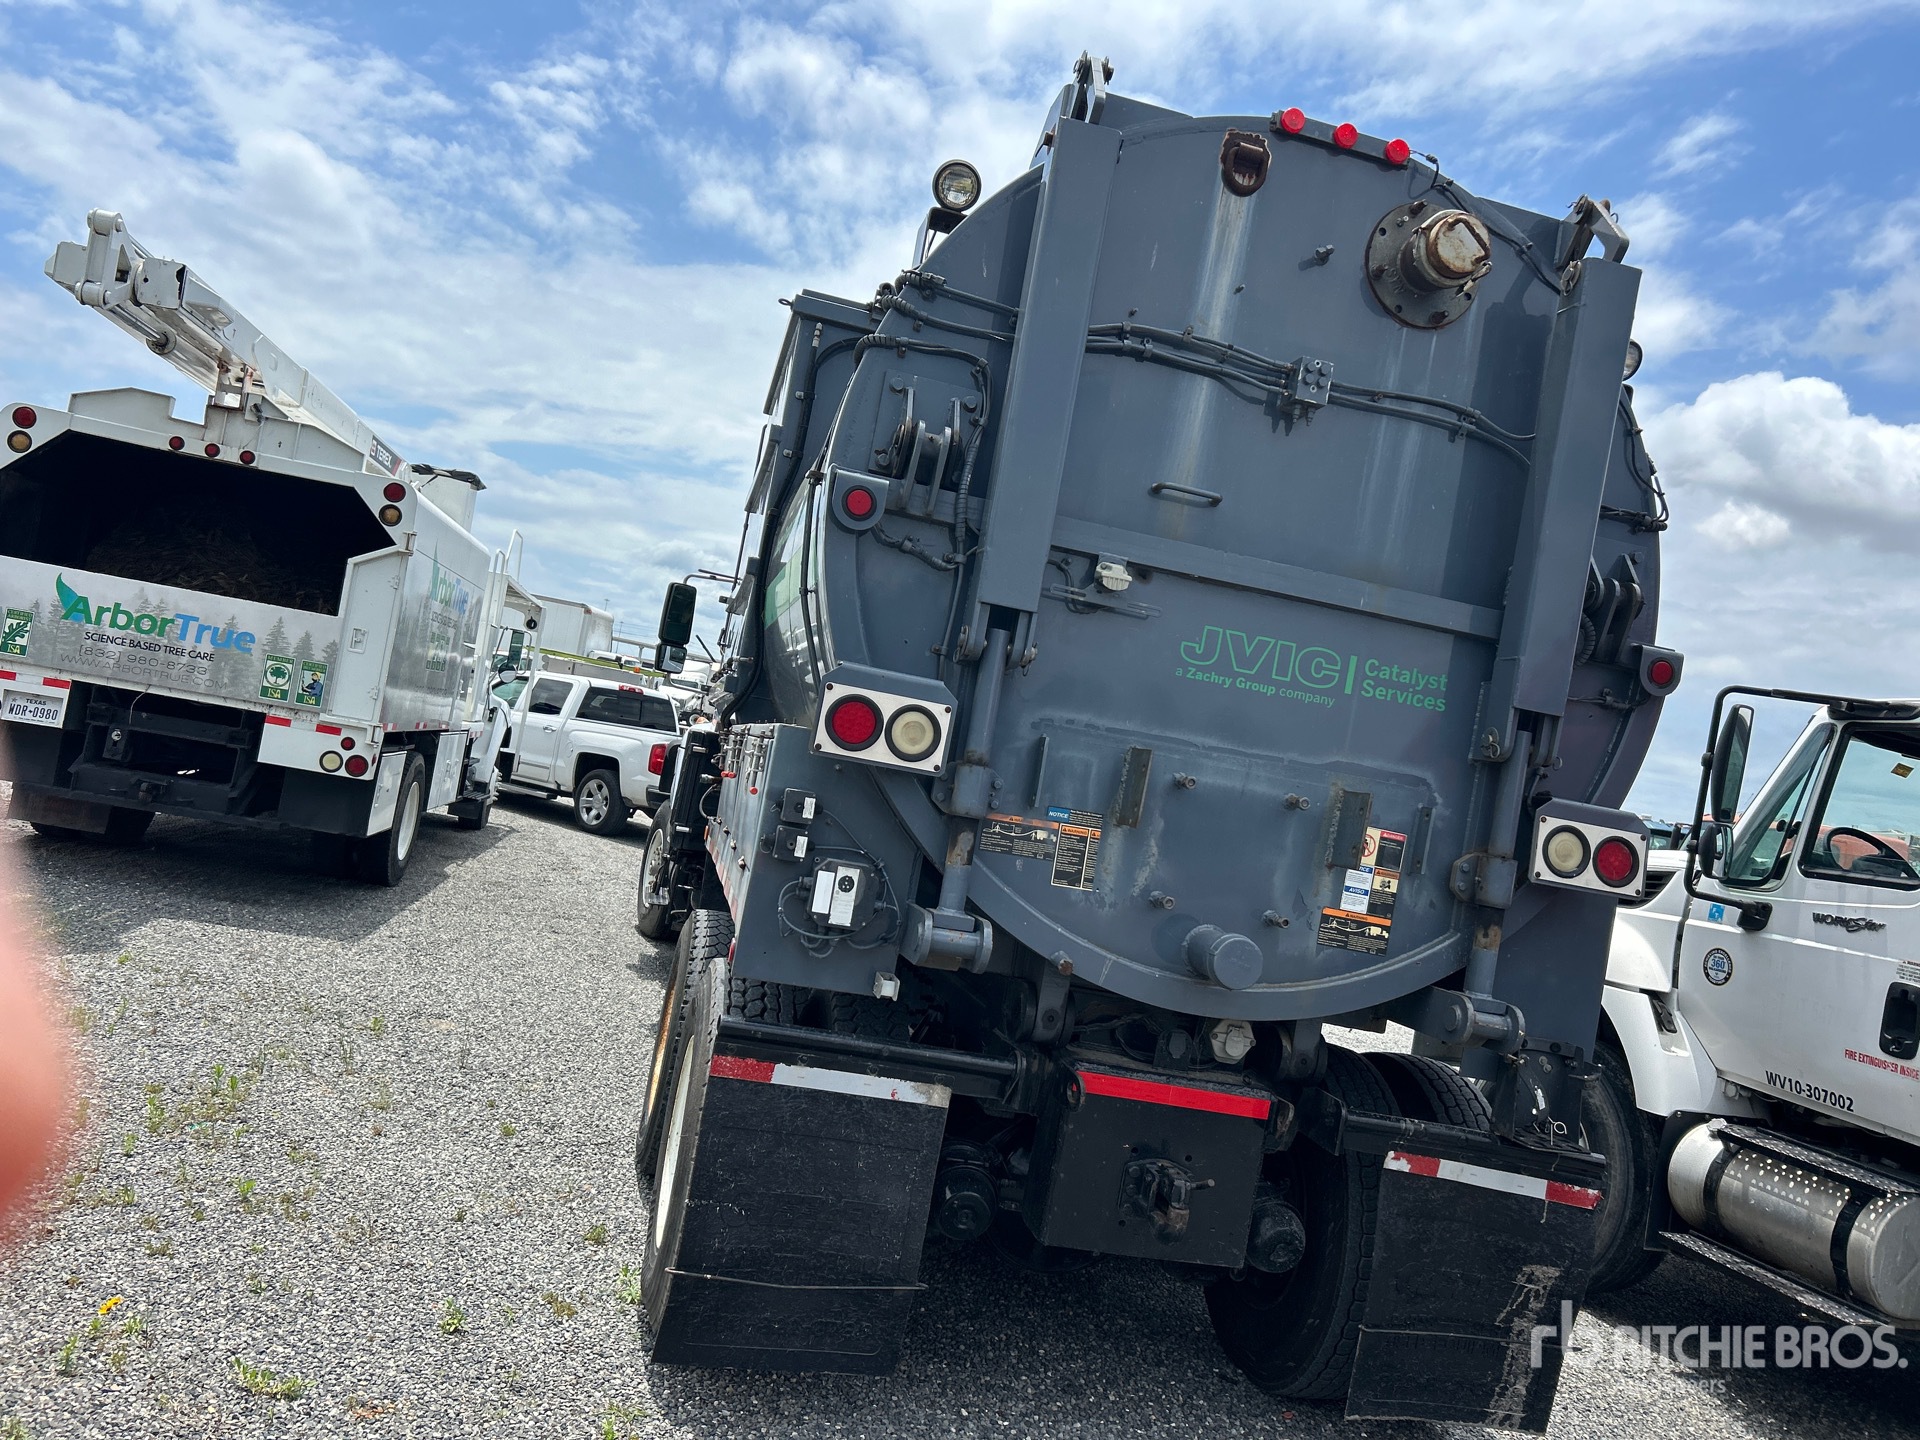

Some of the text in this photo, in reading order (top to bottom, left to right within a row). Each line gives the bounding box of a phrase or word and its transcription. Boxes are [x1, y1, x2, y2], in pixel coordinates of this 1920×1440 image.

[61, 595, 256, 655] ArborTrue
[84, 631, 215, 662] SCIENCE BASED TREE CARE
[1180, 625, 1342, 689] JVIC
[127, 654, 208, 676] 980-8733
[1364, 658, 1448, 692] Catalyst
[26, 698, 47, 706] TEXAS
[1175, 666, 1336, 708] a Zachry Group company
[1360, 679, 1446, 712] Services
[1048, 811, 1069, 819] NOTICE
[1349, 887, 1365, 895] AVISO
[1844, 1049, 1858, 1061] FIRE
[1765, 1070, 1854, 1112] WV10-307002
